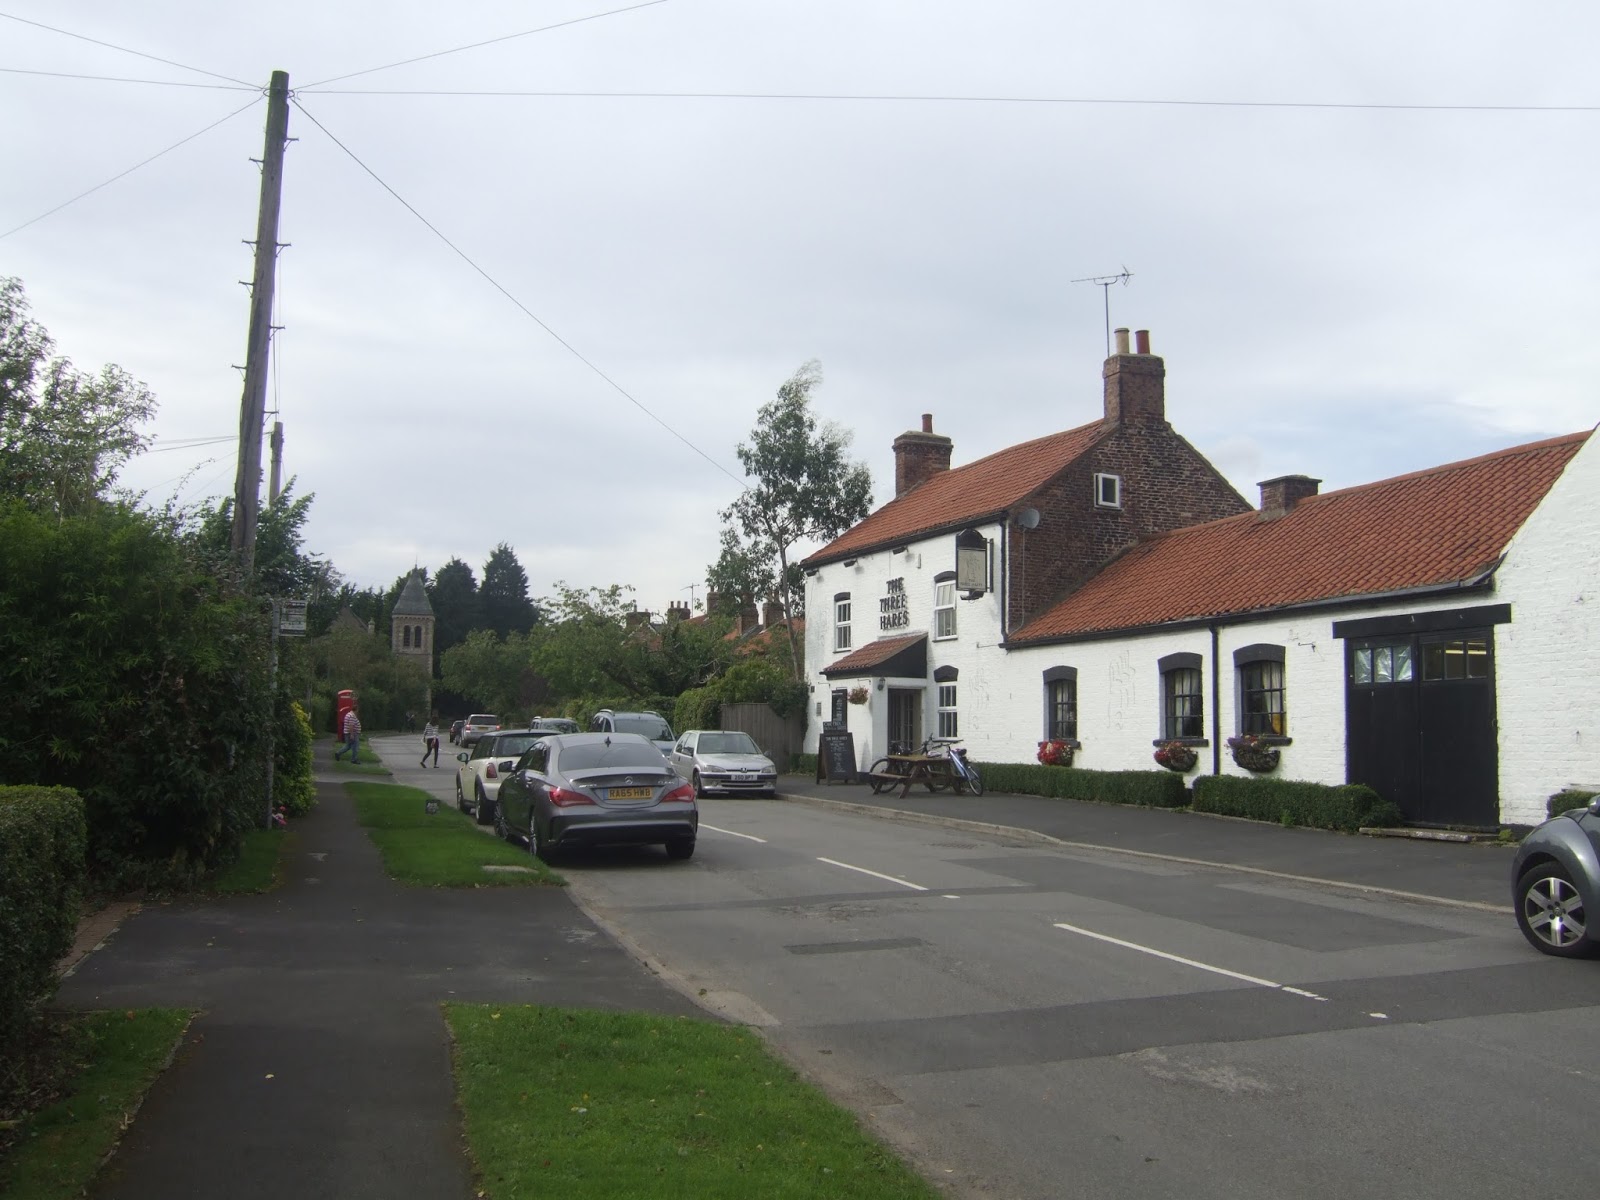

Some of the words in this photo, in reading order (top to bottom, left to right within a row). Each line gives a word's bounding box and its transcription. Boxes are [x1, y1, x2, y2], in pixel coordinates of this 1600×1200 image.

[886, 576, 904, 594] THE
[879, 593, 906, 612] THREE
[880, 610, 909, 629] HARES
